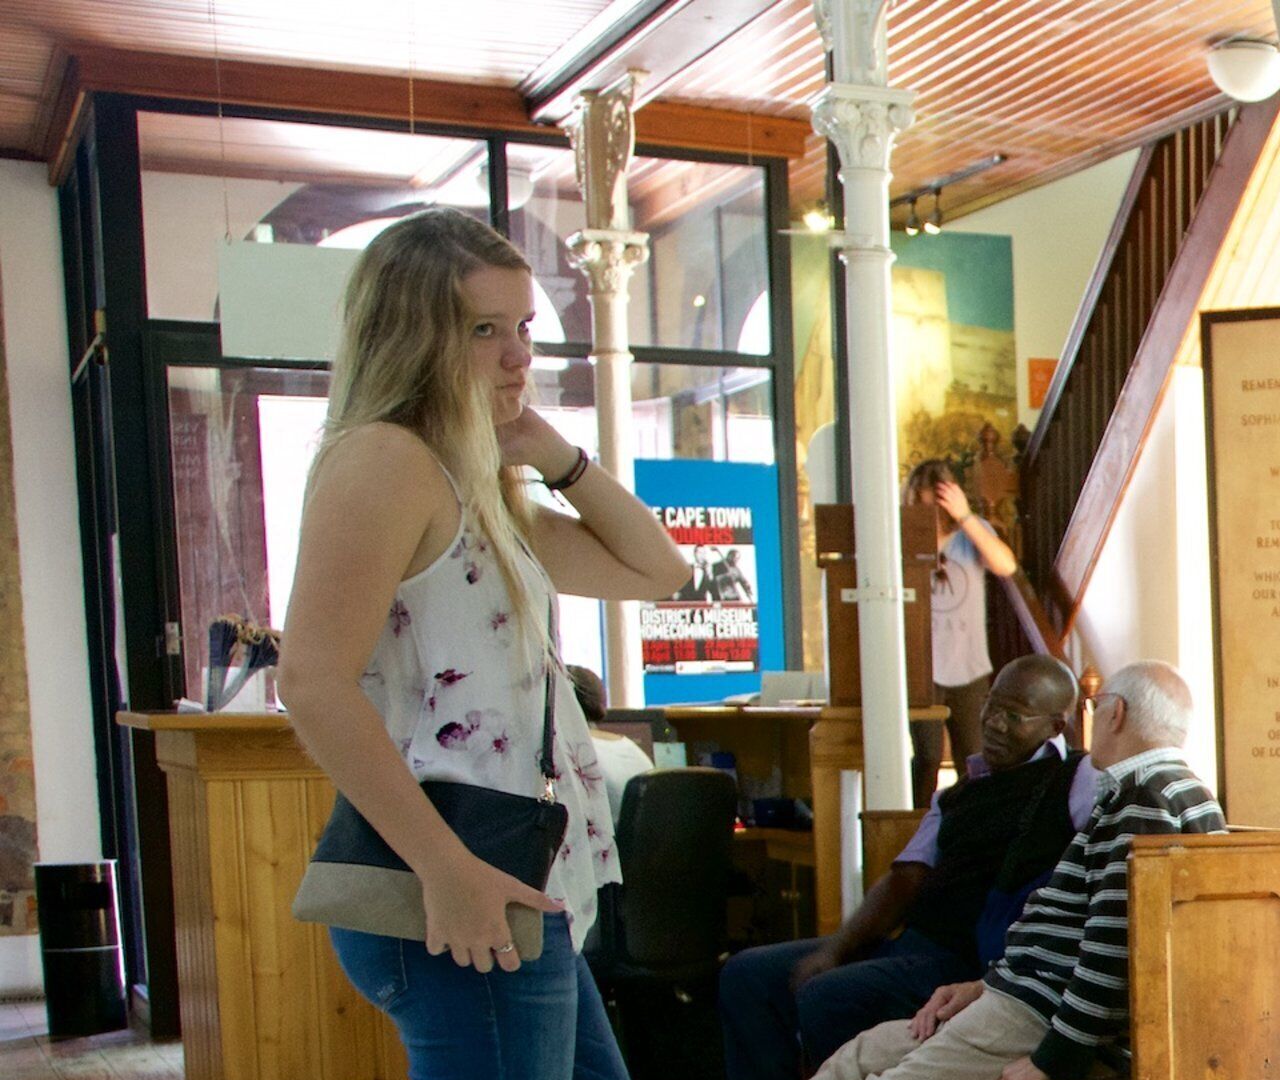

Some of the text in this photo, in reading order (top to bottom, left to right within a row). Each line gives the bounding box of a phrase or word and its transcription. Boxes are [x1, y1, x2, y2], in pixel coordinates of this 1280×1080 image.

[665, 506, 752, 527] CAPE TOWN
[642, 609, 690, 623] DISTRICT
[703, 609, 753, 623] MUSEUM
[716, 623, 758, 639] CENTRE
